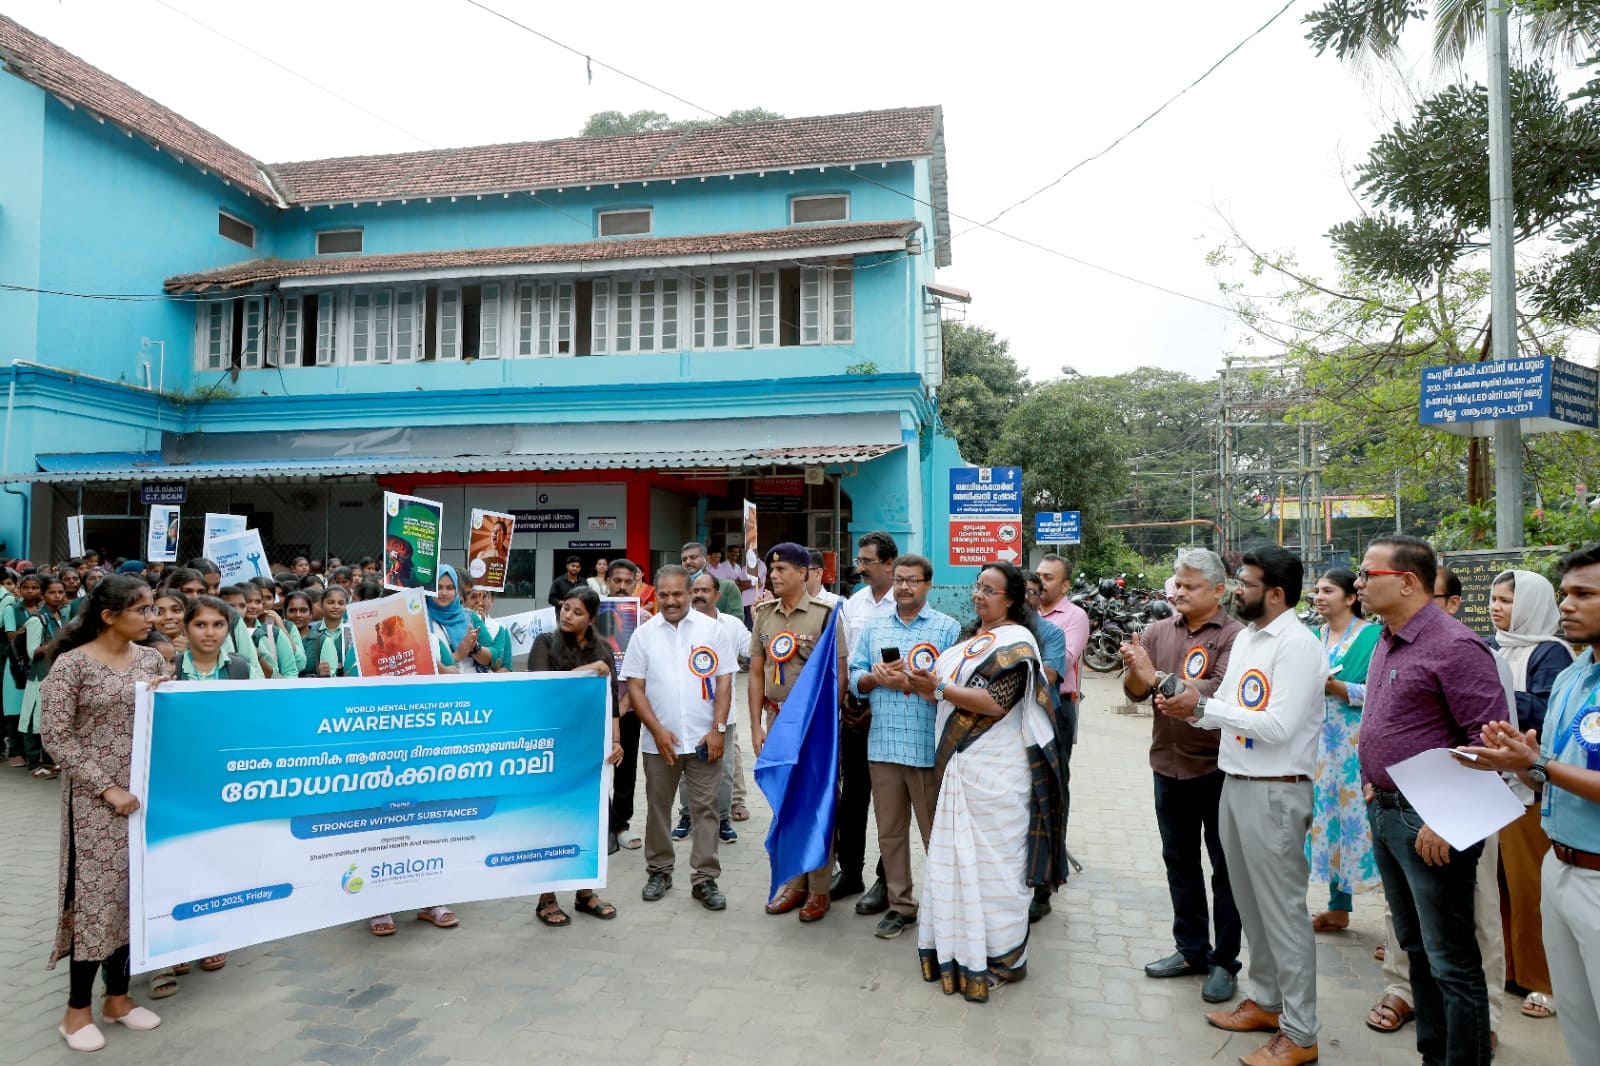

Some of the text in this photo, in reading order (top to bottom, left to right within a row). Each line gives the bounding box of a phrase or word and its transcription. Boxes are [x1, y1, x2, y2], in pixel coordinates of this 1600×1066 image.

[1461, 401, 1533, 418] ആശുപത്രി
[345, 700, 471, 714] WORLD MENTAL HEALTH DAY 2025
[317, 709, 493, 734] AWARENESS RALLY
[227, 758, 272, 772] ലോക
[276, 752, 342, 768] മാനസിക
[345, 750, 408, 765] ആരോഗ്യ
[221, 750, 555, 803] ബോധവൽക്കരണ റാലി
[311, 807, 478, 833] STRONGER WITHOUT SUBSTANCES
[309, 852, 333, 862] Shalom
[334, 849, 360, 858] Institute
[368, 844, 389, 853] Mental
[389, 841, 409, 850] Health
[410, 839, 421, 847] And
[490, 847, 575, 864] @ Fort Maidan, Palakkad
[370, 857, 444, 879] shalom
[192, 890, 273, 913] Oct 10 2025, Friday
